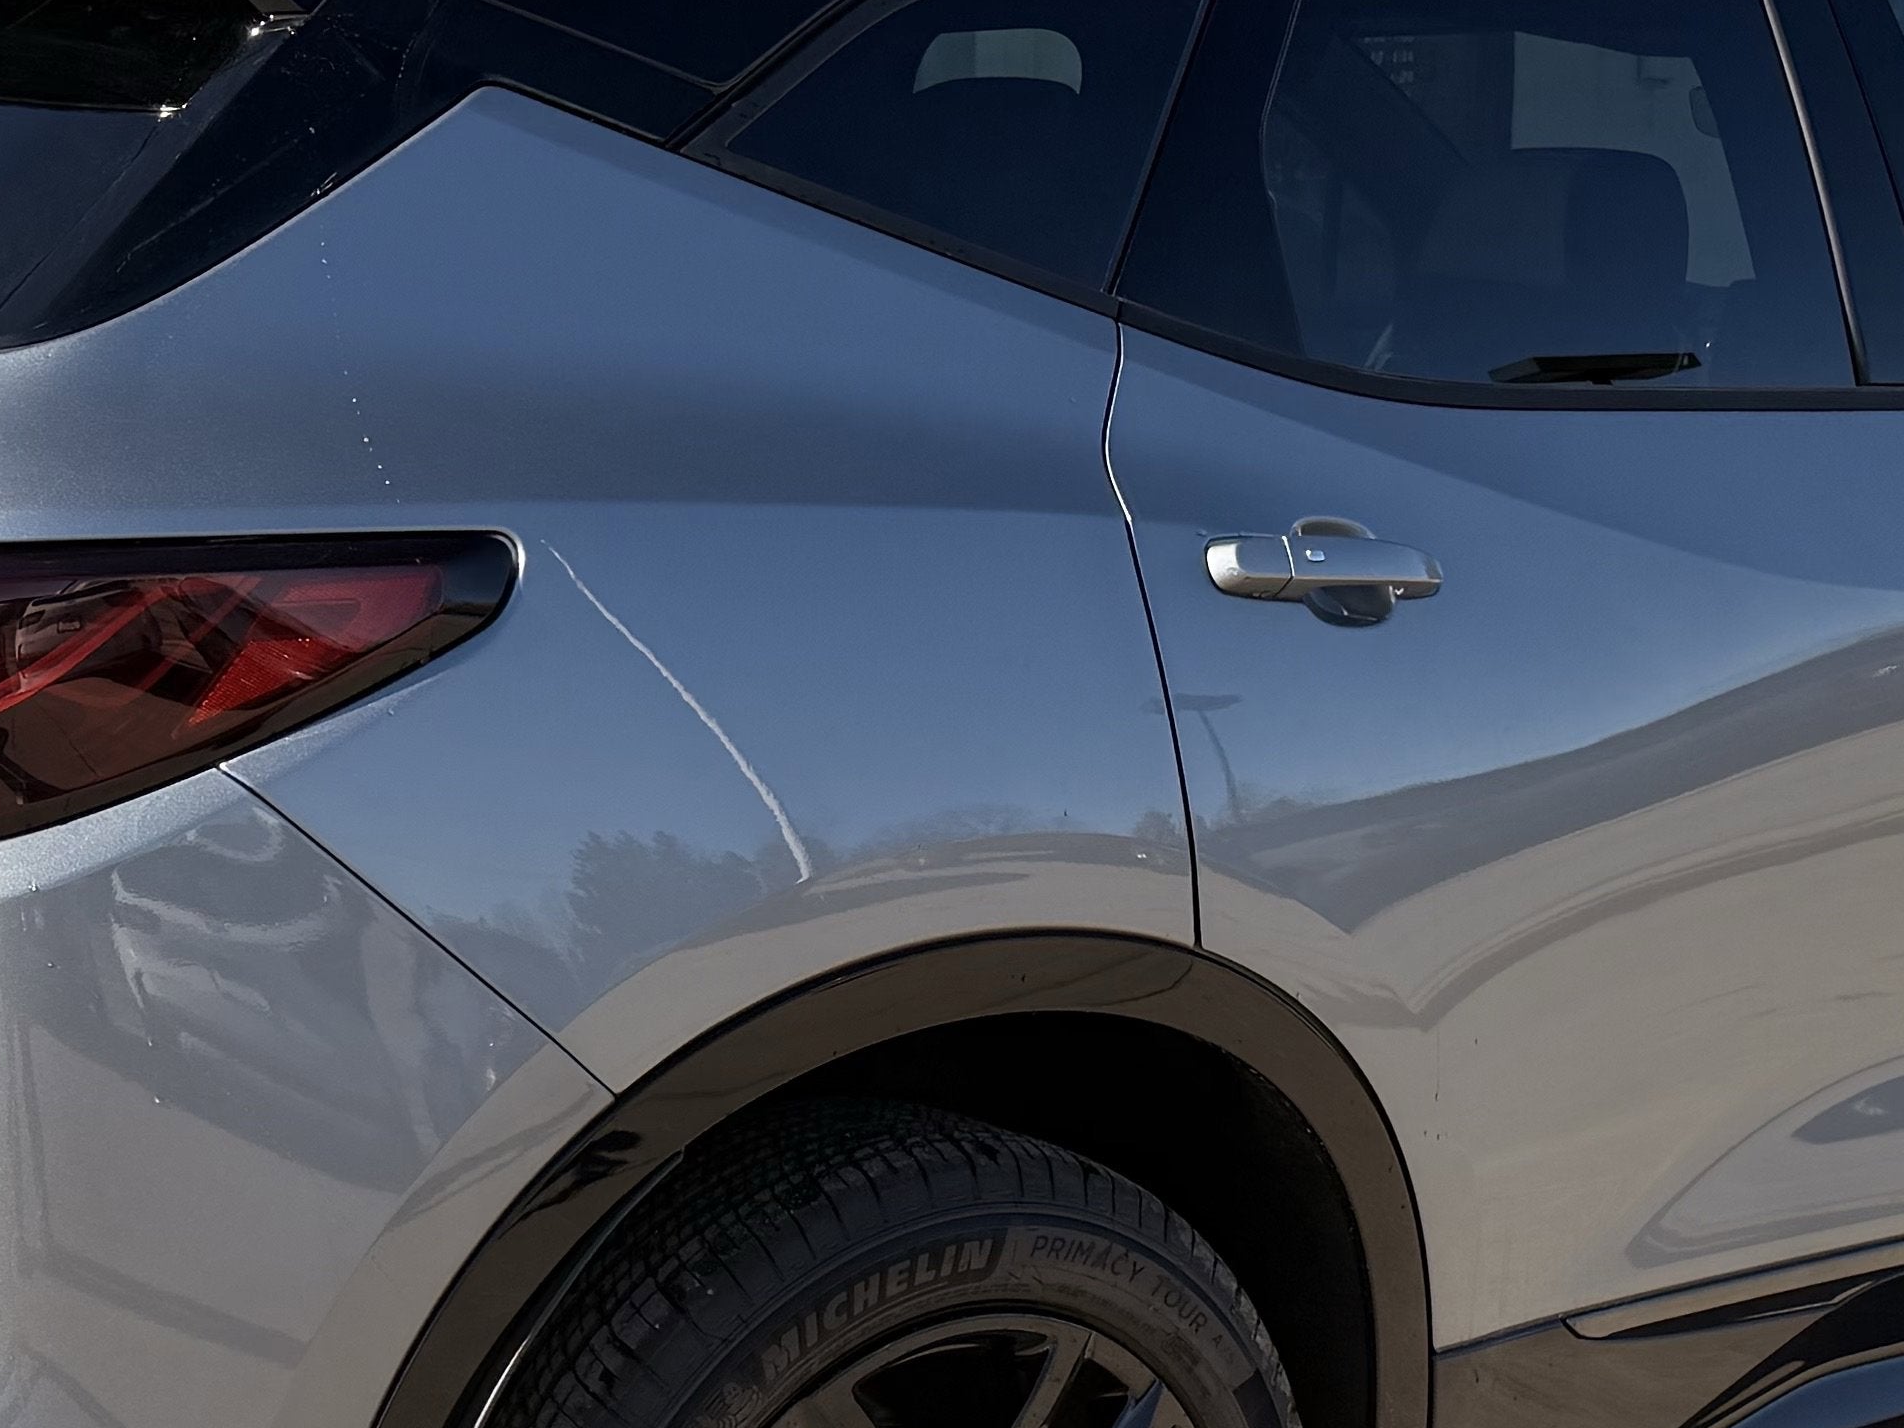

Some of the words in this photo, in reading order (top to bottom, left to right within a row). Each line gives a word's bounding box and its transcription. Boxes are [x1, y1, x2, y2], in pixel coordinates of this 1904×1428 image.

[761, 1238, 994, 1381] MICHELIN
[1030, 1235, 1145, 1283] PRIMACY
[1151, 1274, 1209, 1333] TOUR
